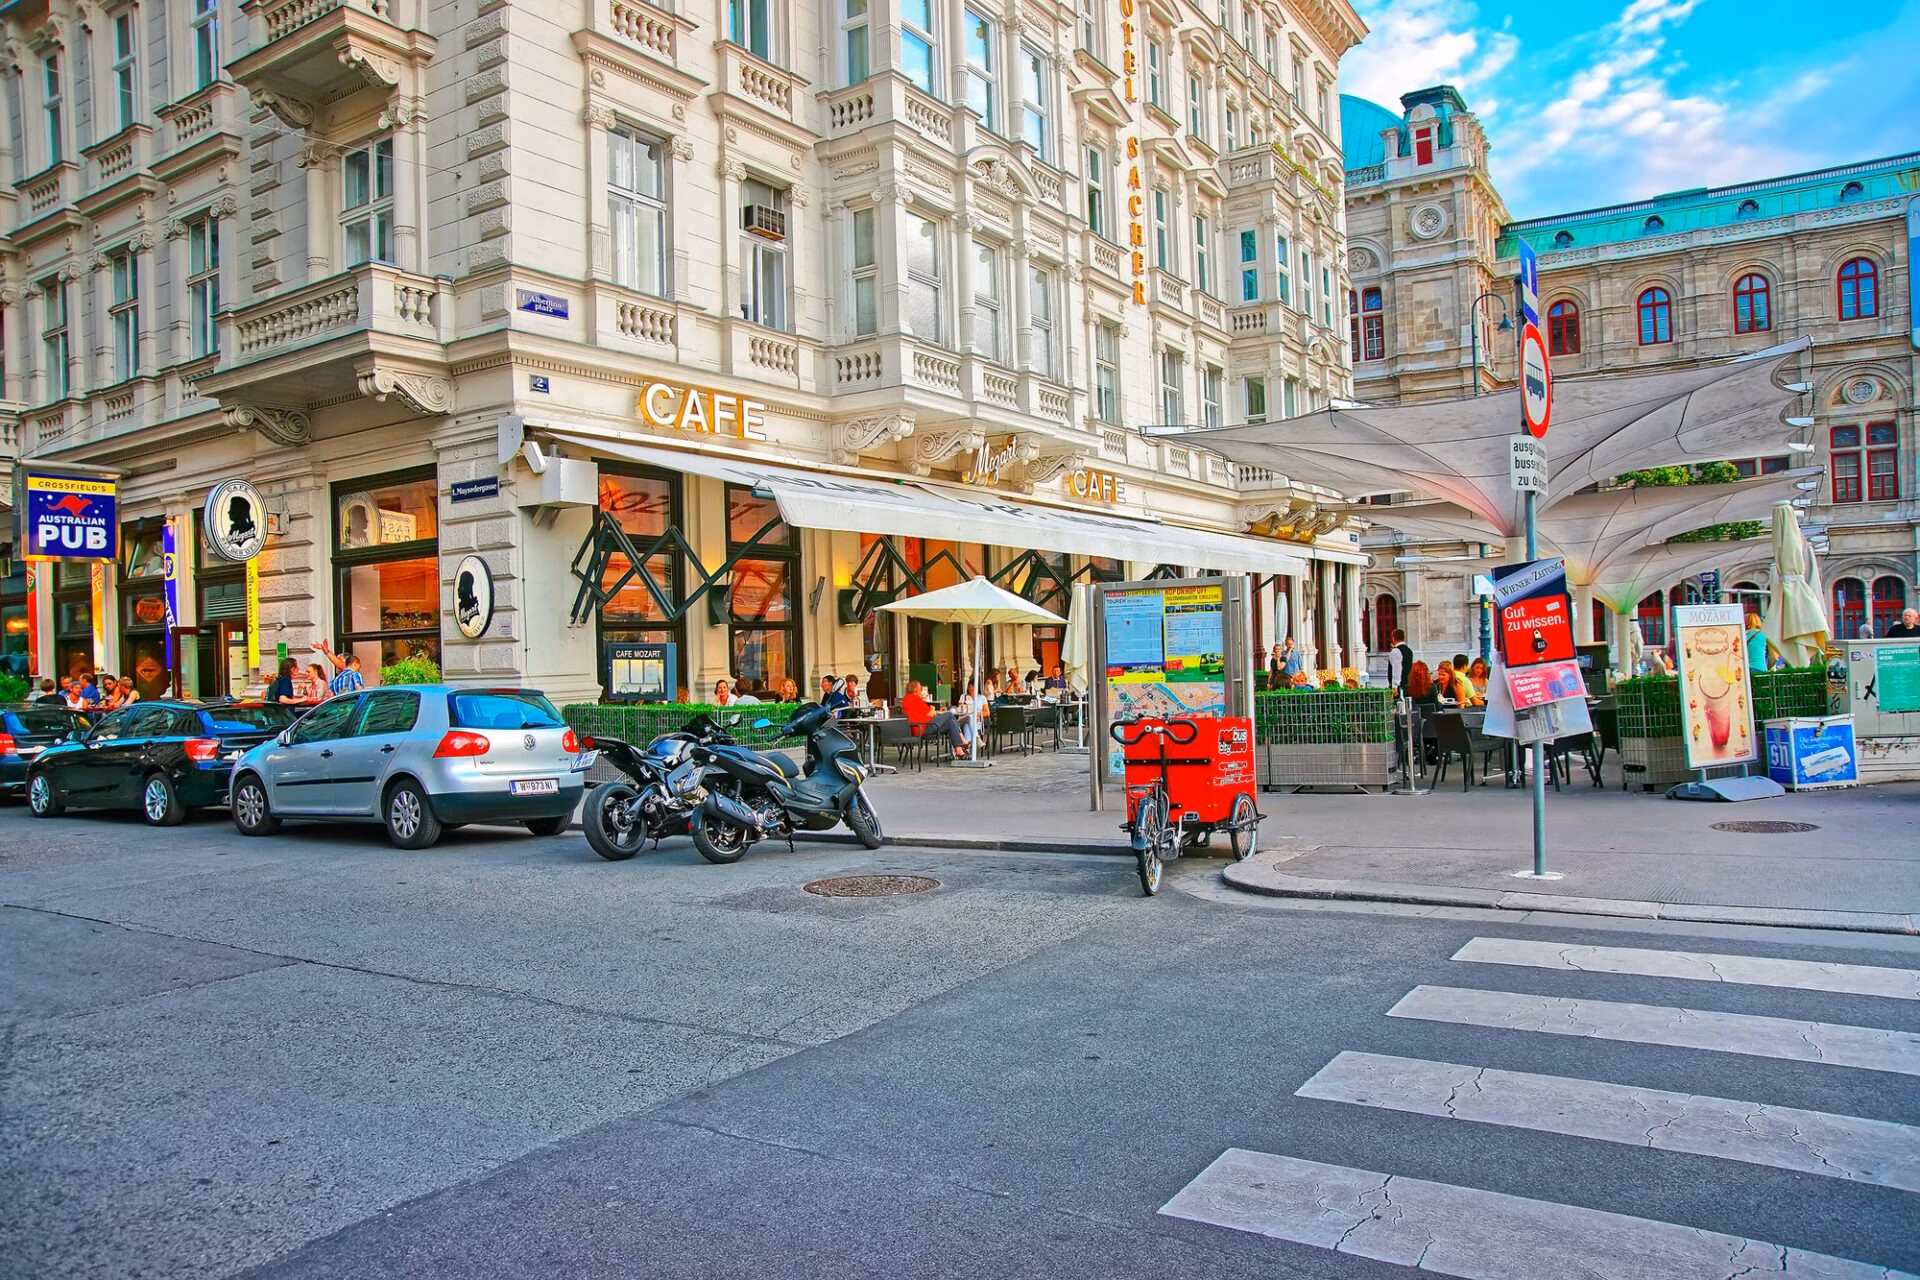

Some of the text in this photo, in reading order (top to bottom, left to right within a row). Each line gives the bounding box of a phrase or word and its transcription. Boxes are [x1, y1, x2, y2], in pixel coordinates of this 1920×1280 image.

[1127, 136, 1146, 306] SACHER
[534, 303, 554, 313] platz
[536, 377, 544, 388] 2
[641, 383, 766, 442] CAFE
[965, 435, 1018, 484] Mozart
[38, 481, 107, 492] CROSSFIELD'S
[1070, 469, 1127, 504] CAFE
[1518, 476, 1529, 486] zu
[39, 514, 106, 526] AUSTRALIAN
[38, 524, 108, 549] PUB
[1500, 561, 1562, 597] WIENER ZEITUNG
[1504, 606, 1526, 619] Gut
[1690, 610, 1731, 622] MOZART
[1507, 615, 1566, 632] zu wissen.
[616, 650, 662, 658] CAFE MOZART
[1770, 744, 1790, 767] sn
[520, 783, 526, 792] W
